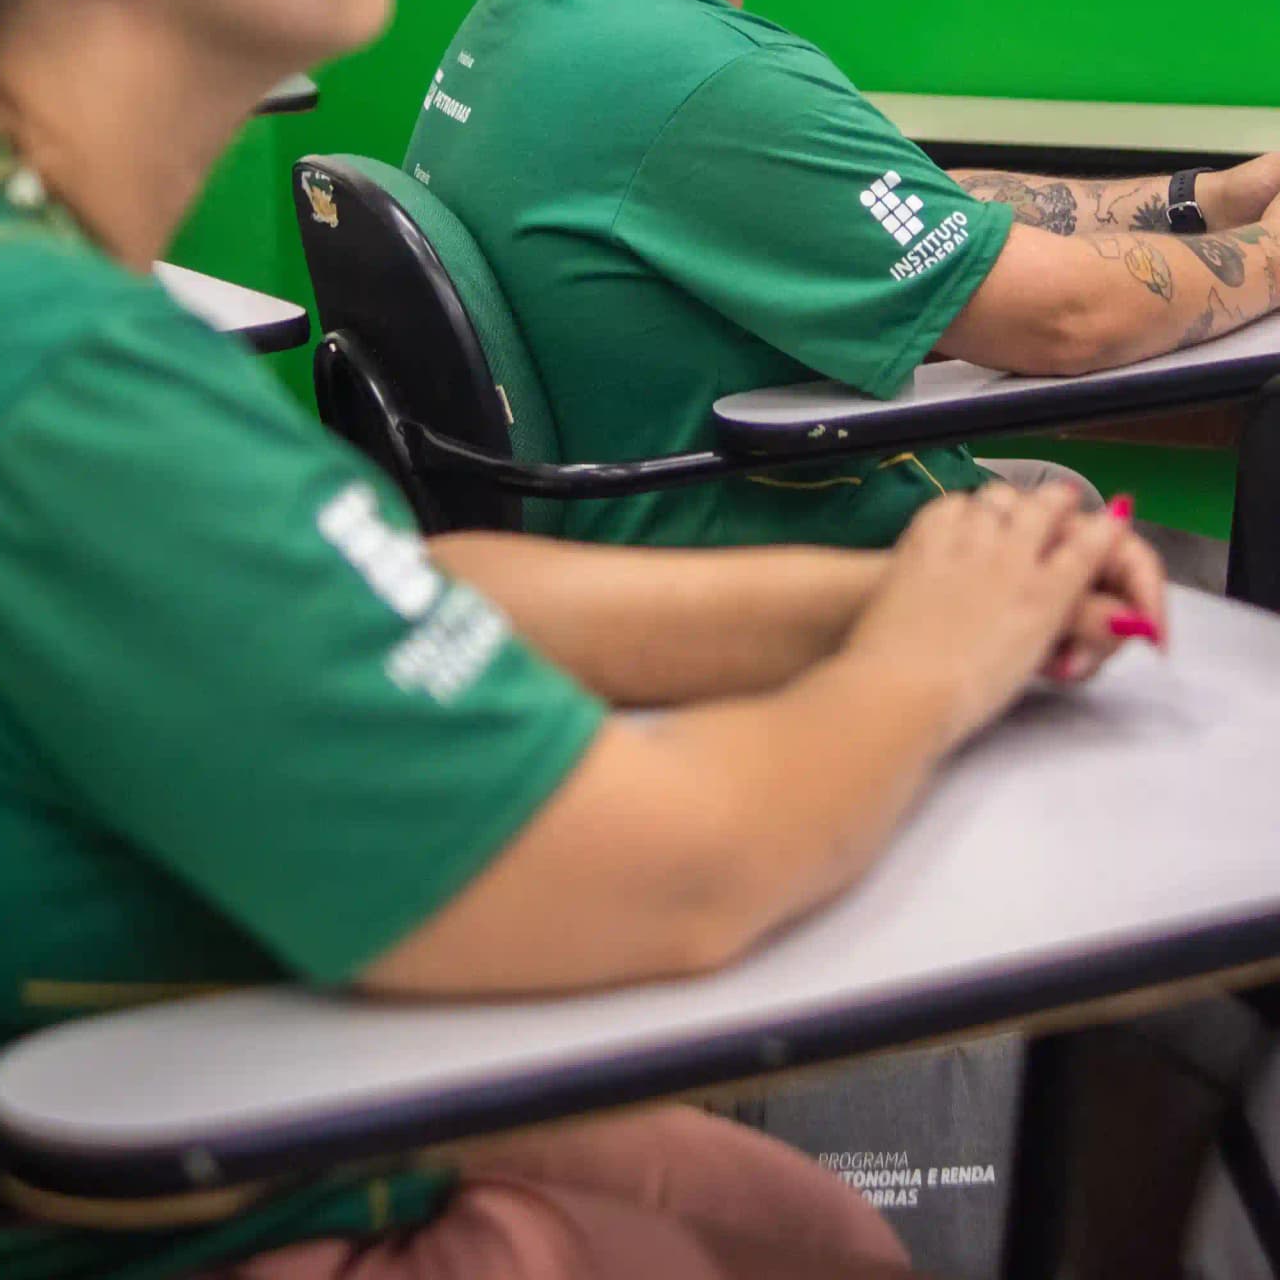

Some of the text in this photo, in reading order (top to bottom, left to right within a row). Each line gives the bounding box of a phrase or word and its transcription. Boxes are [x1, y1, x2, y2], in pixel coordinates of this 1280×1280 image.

[889, 211, 968, 282] INSTITUTO
[819, 1151, 909, 1169] PROGRAMA
[837, 1165, 996, 1188] TONOMIA E RENDA
